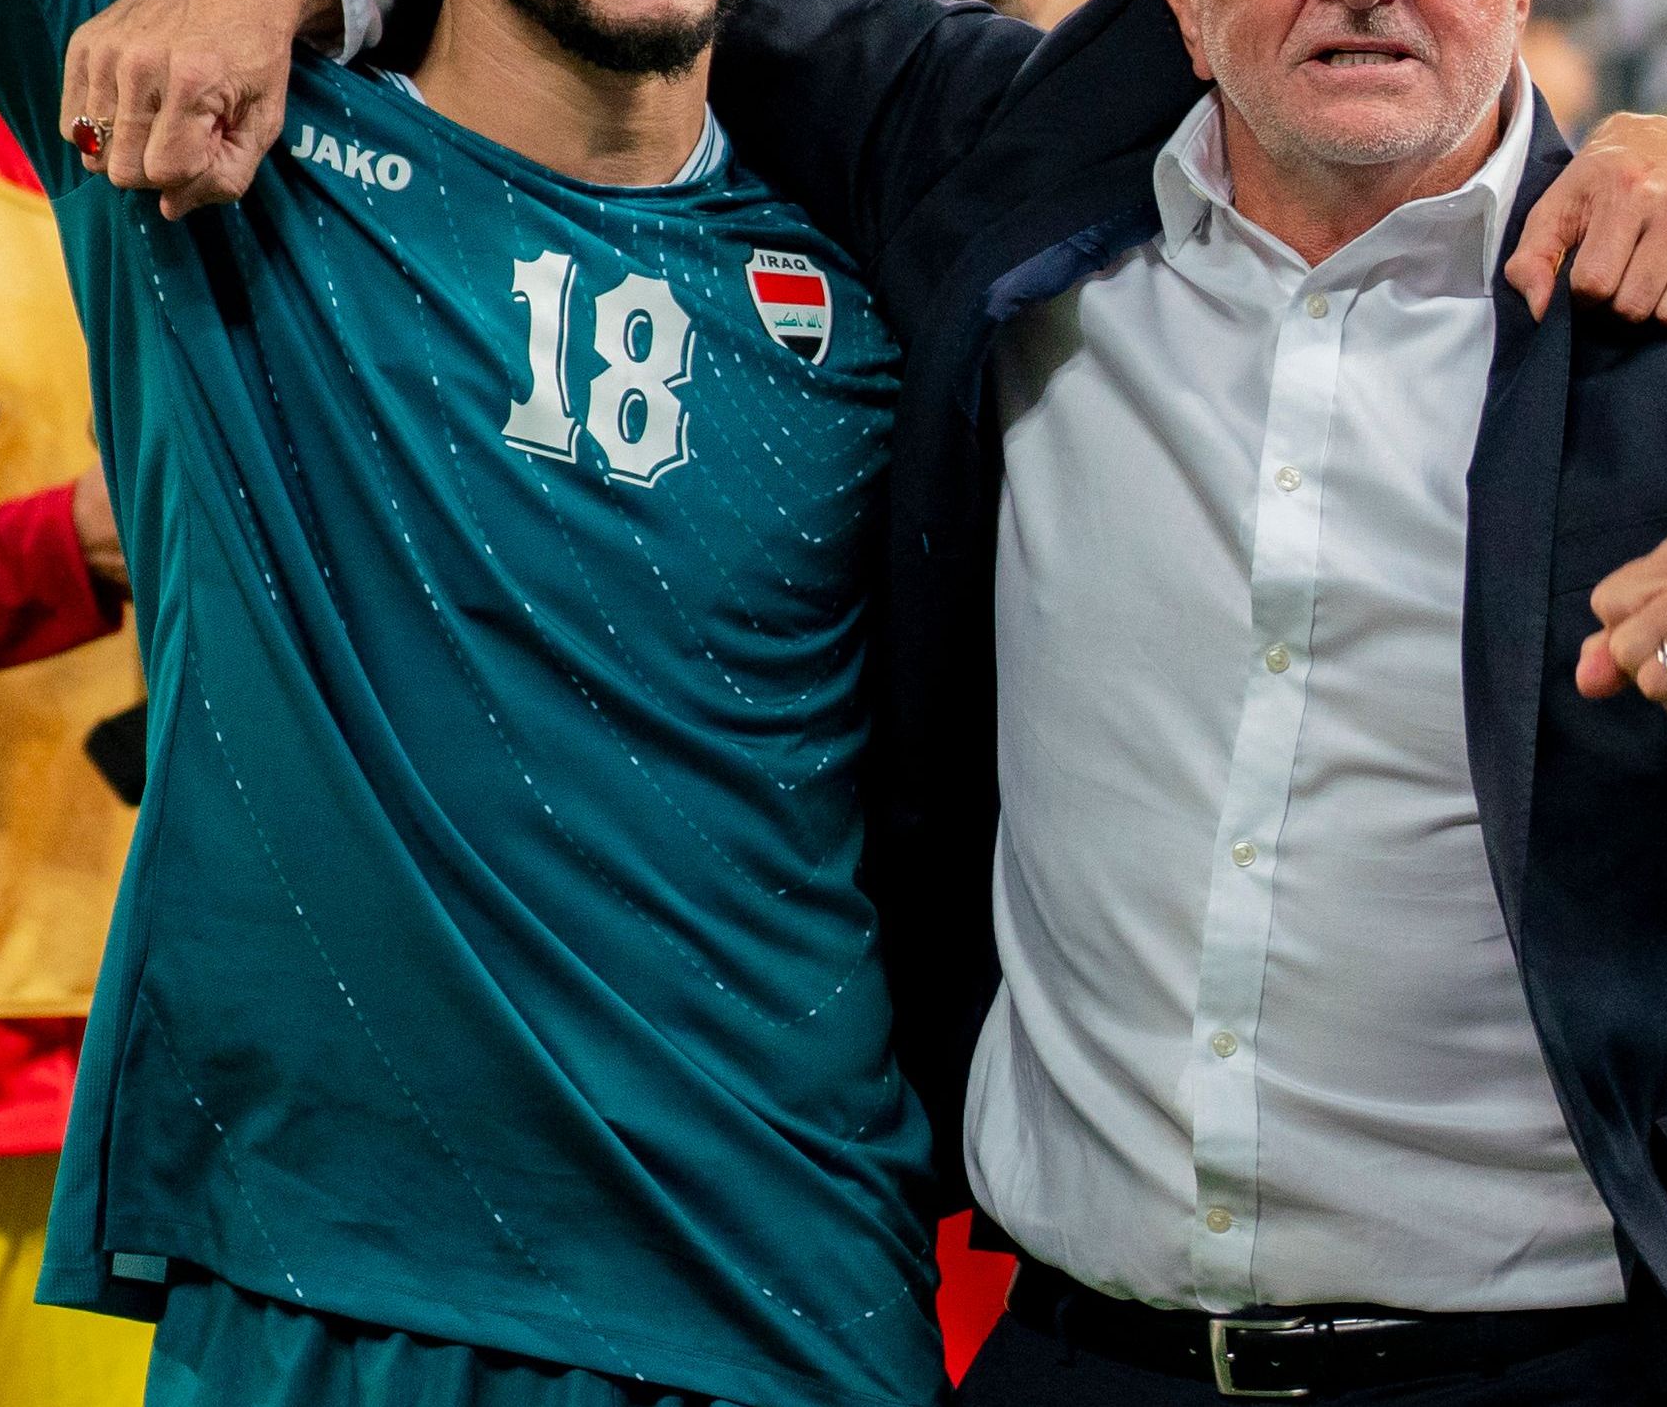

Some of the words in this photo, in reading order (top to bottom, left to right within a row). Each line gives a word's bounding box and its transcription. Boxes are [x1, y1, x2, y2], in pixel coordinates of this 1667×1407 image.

[291, 124, 412, 192] JAKO
[759, 254, 808, 272] IRAQ
[502, 249, 696, 488] 18
